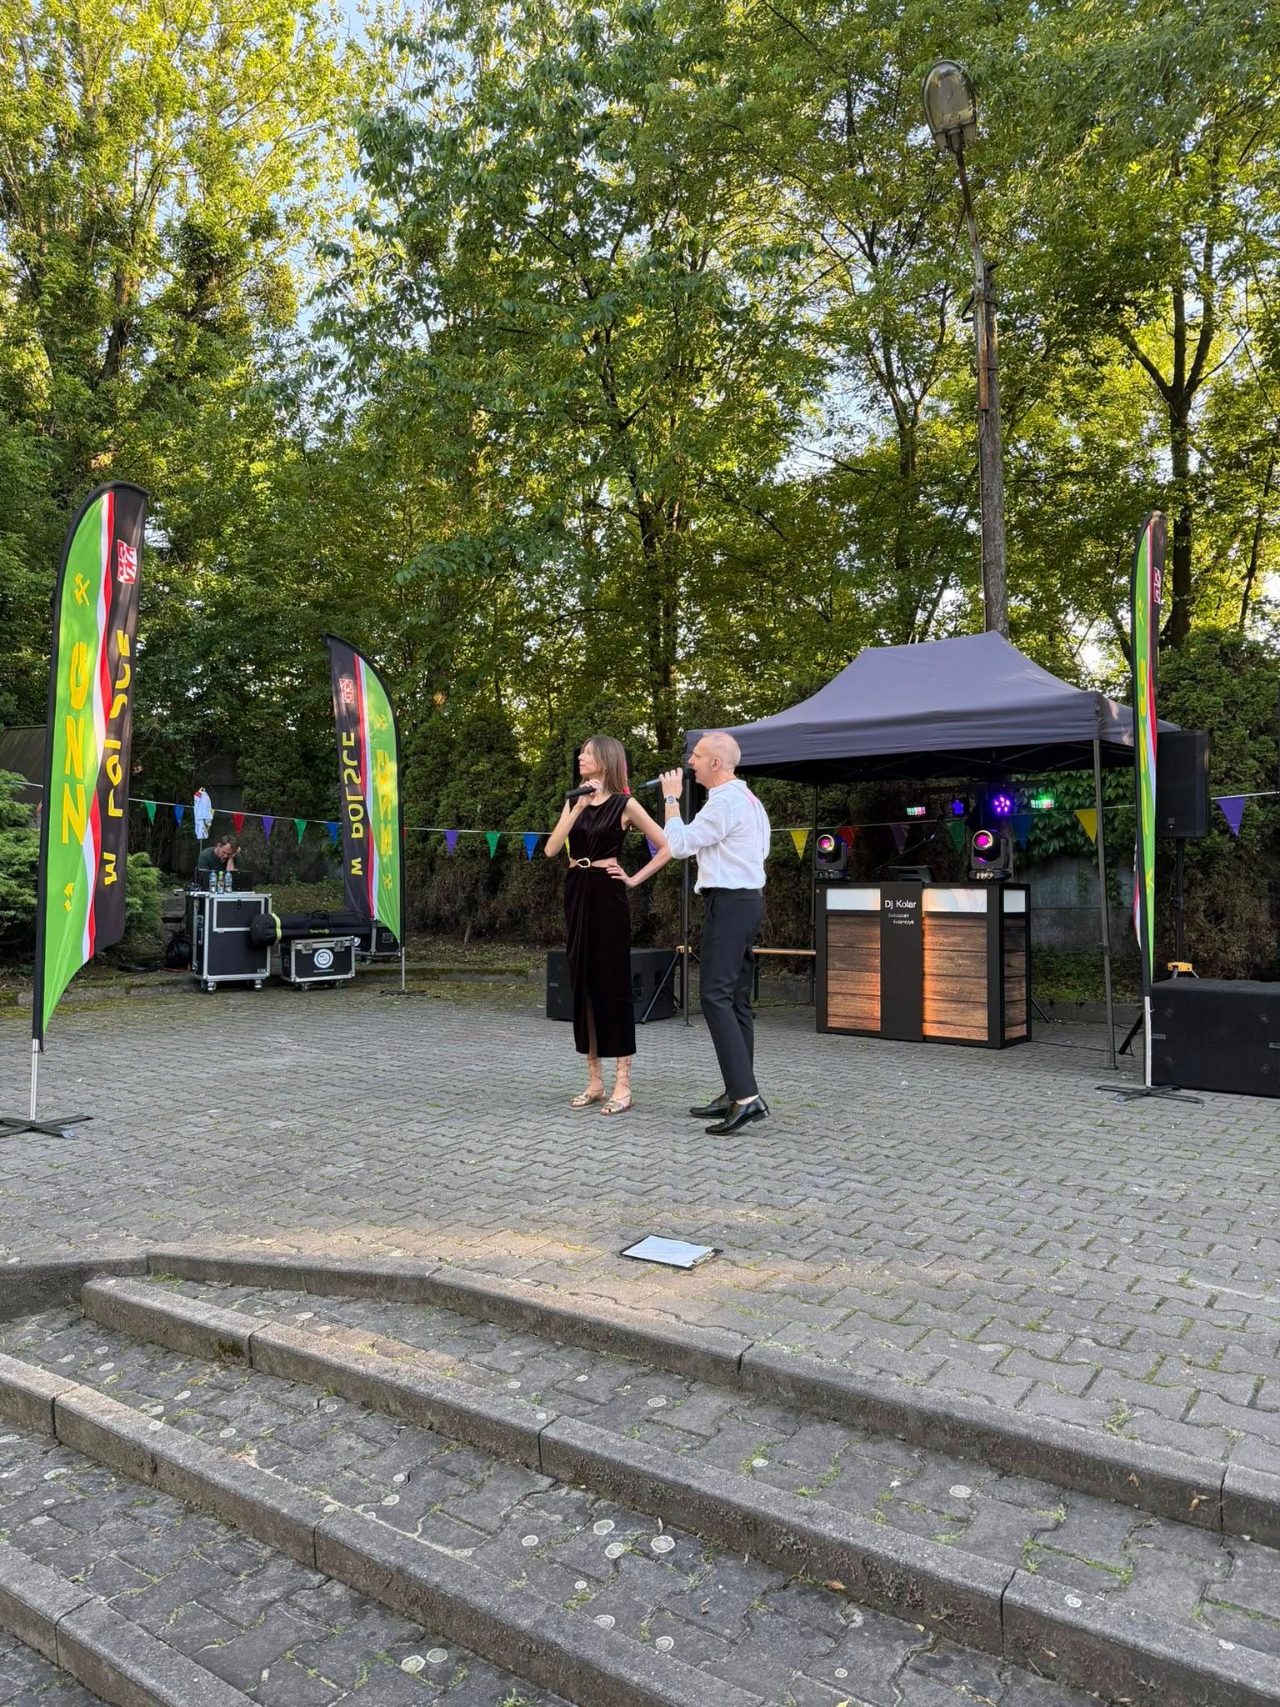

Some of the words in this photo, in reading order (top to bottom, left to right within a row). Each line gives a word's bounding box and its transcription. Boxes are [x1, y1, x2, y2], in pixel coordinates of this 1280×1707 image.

[62, 642, 89, 846] ZZG
[884, 900, 893, 909] Dj
[896, 900, 917, 908] Kolar
